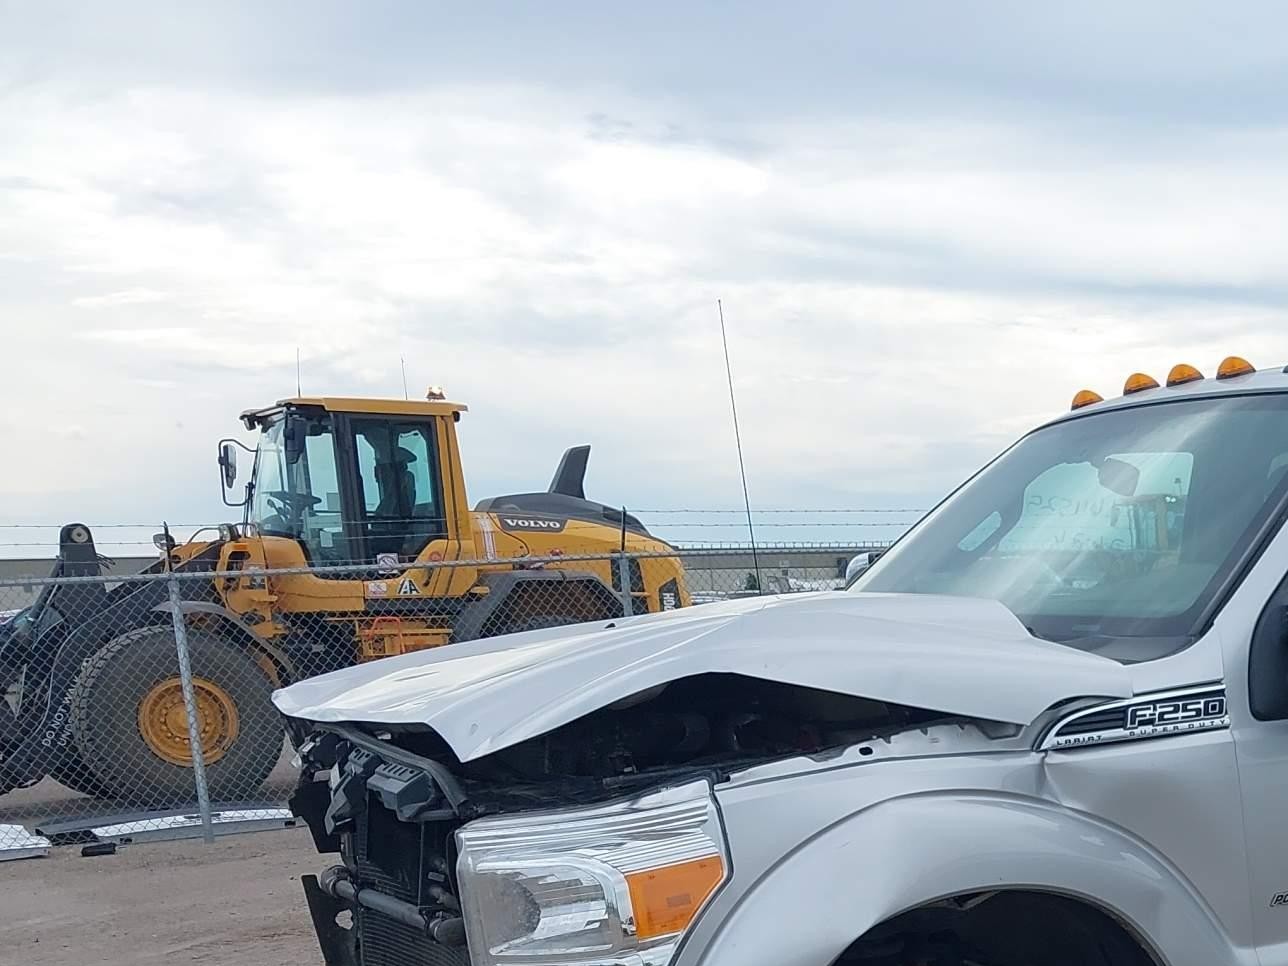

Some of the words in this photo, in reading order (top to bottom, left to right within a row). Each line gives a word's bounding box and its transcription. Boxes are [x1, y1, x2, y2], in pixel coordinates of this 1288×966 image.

[503, 517, 561, 529] VOLVO
[1126, 697, 1227, 729] F-250
[41, 730, 56, 747] DO
[51, 705, 68, 730] NOT
[1128, 725, 1181, 737] SUPER
[1188, 718, 1227, 731] DUTY
